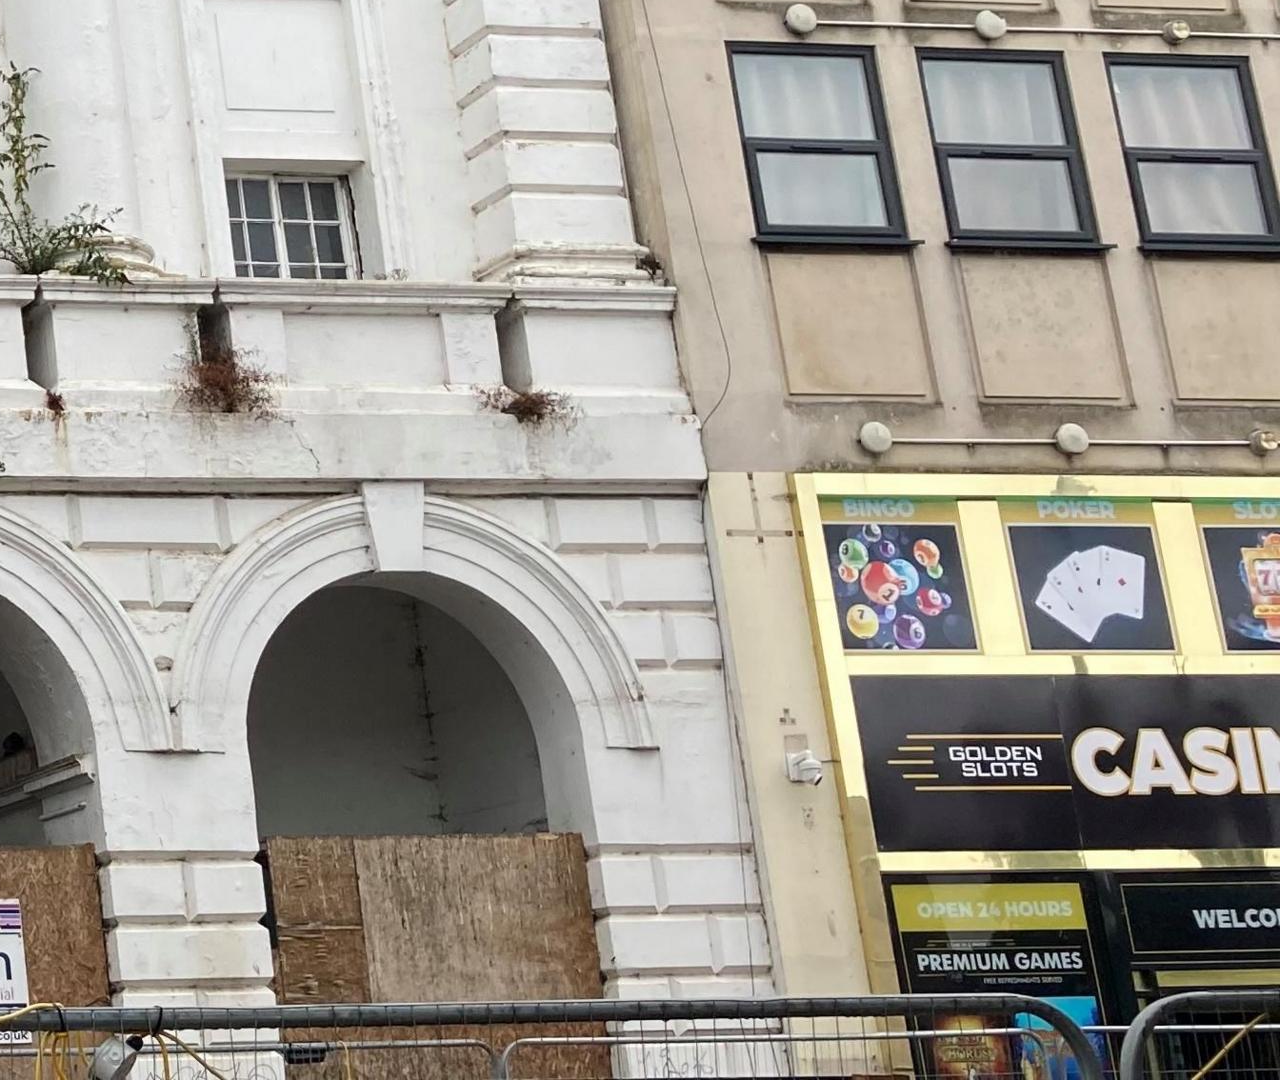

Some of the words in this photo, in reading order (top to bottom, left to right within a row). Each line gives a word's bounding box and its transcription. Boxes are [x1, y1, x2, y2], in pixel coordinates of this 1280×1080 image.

[842, 500, 916, 519] BINGO
[1037, 500, 1116, 521] POKER
[1233, 502, 1280, 520] SLO
[948, 746, 1042, 761] GOLDEN
[962, 762, 1038, 777] SLOTS
[917, 901, 973, 919] OPEN
[978, 901, 1001, 918] 24
[1005, 900, 1073, 918] HOURS
[1192, 908, 1280, 929] WELCO
[917, 953, 1010, 971] PREMIUM
[1014, 952, 1083, 970] GAMES
